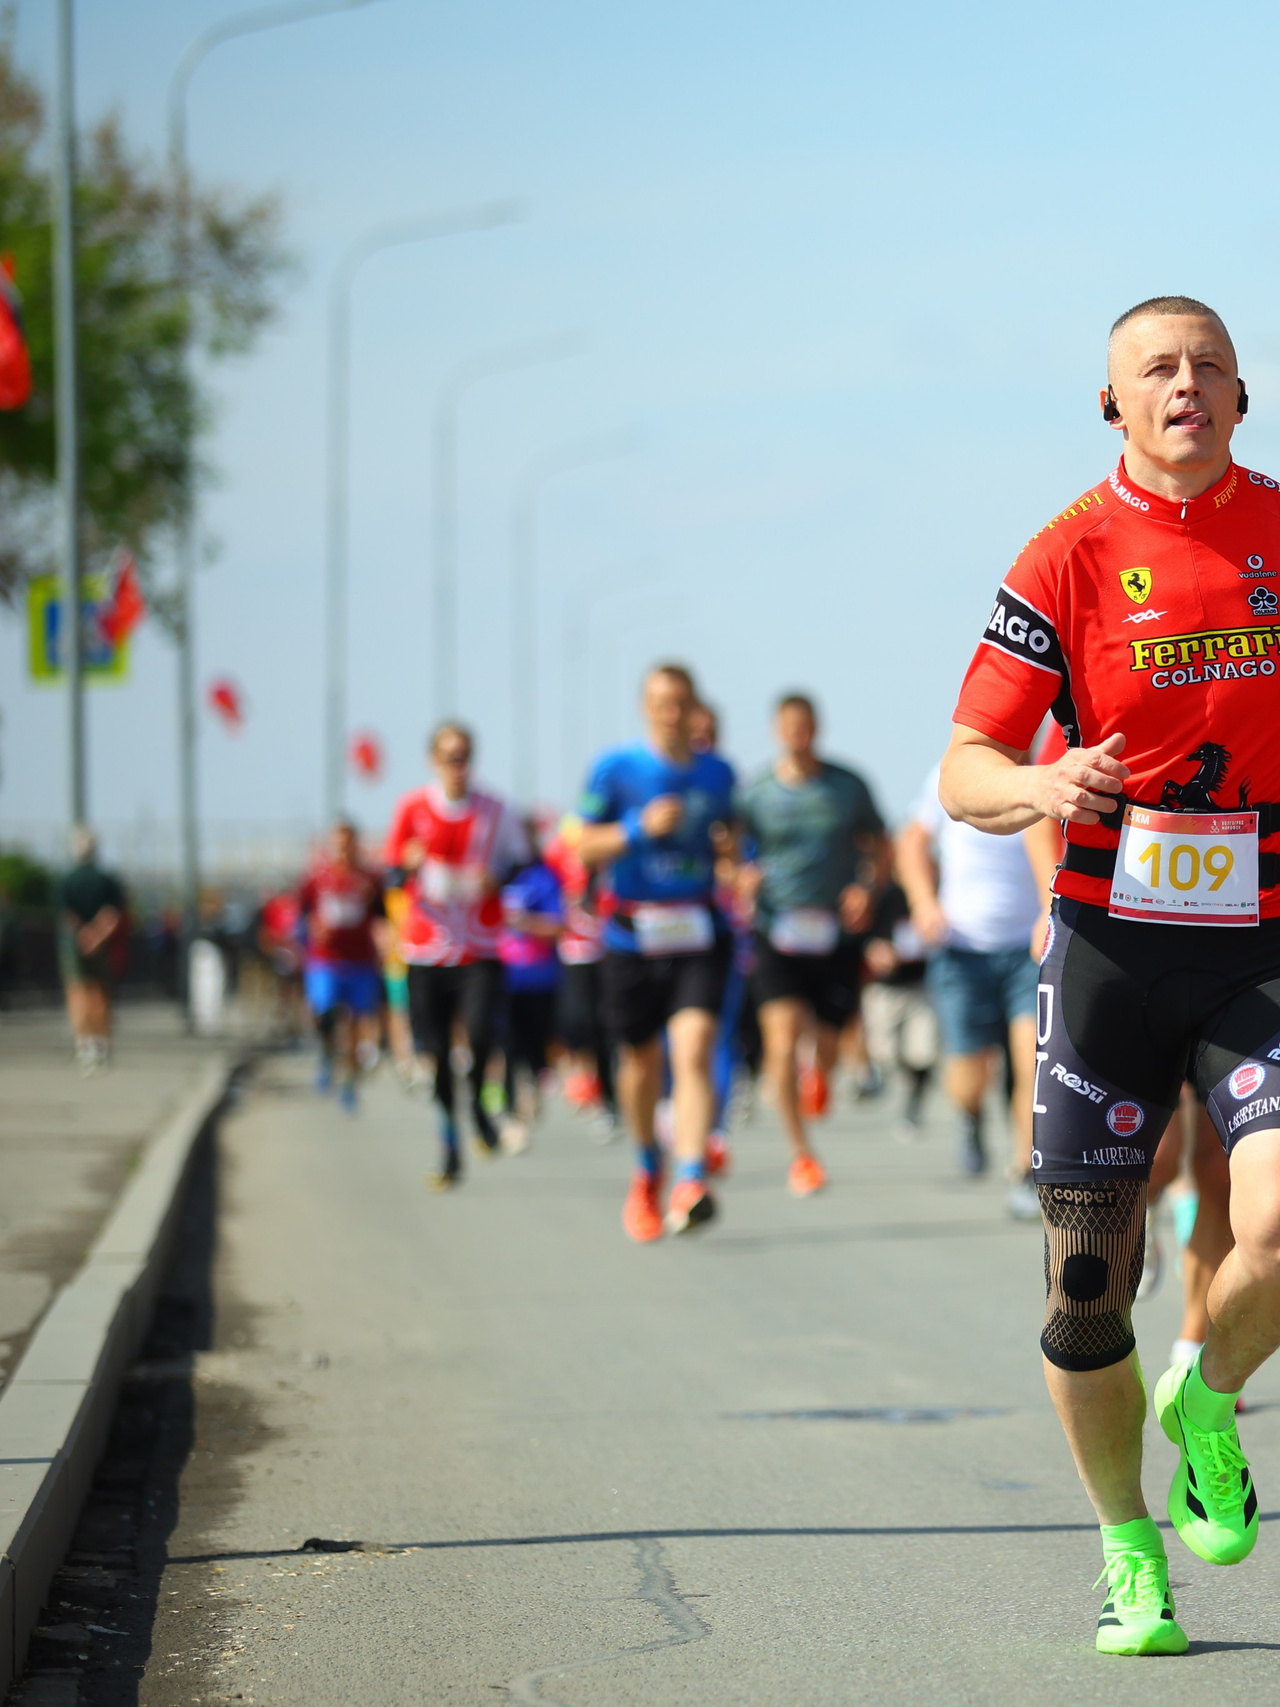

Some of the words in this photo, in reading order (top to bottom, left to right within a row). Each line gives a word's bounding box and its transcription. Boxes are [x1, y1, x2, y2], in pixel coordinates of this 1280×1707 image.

[1238, 570, 1278, 579] vodafone
[988, 600, 1051, 654] AGO
[1151, 659, 1276, 689] COLNAGO
[1137, 842, 1235, 892] 109
[1082, 1146, 1146, 1166] LAURETANA
[1053, 1188, 1115, 1206] copper
